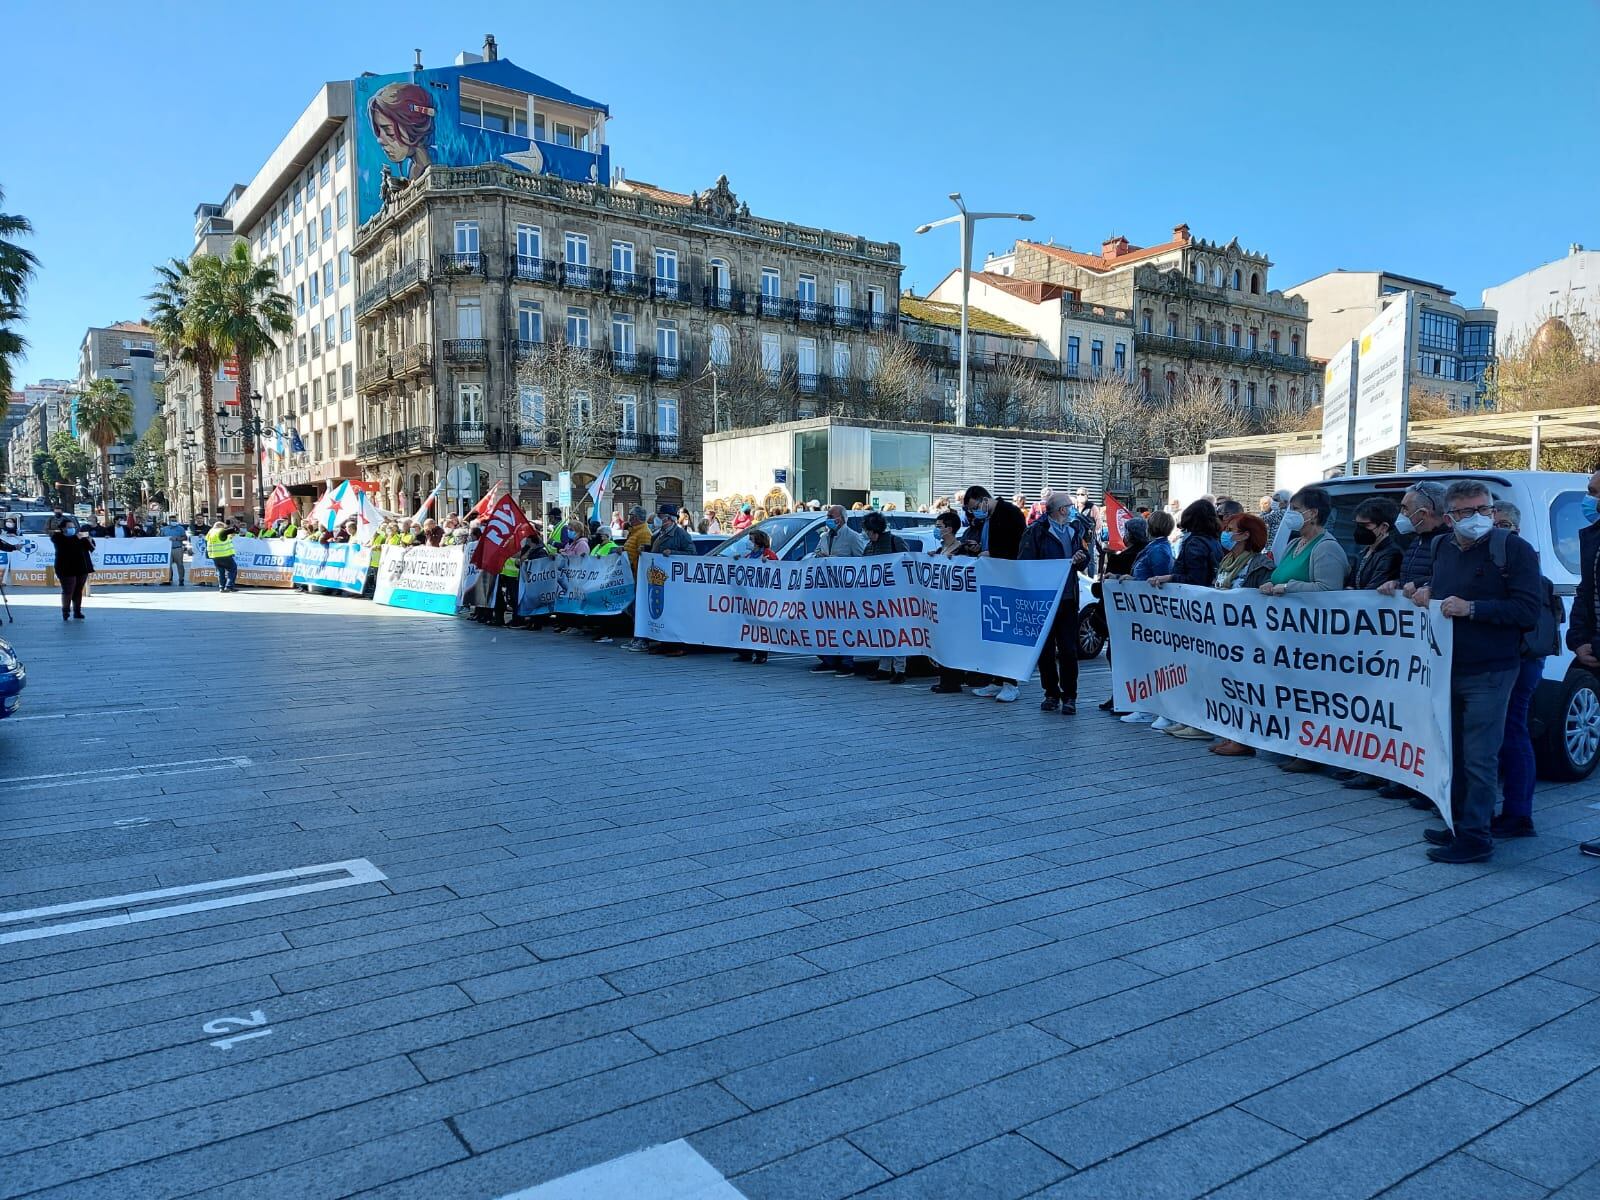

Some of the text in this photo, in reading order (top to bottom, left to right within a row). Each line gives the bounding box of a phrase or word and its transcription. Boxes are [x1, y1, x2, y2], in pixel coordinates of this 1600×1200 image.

[105, 554, 167, 564] SALVATERRA
[256, 556, 284, 566] ARBO
[527, 568, 556, 583] Contra
[671, 561, 782, 590] PLATAFORMA
[804, 562, 896, 590] SANIDADE
[708, 594, 940, 624] LOITANDO POR UNHA SANIDADE
[1015, 611, 1047, 626] GALEG
[1112, 591, 1137, 612] EN
[1138, 593, 1217, 626] DEFENSA
[1223, 603, 1258, 630] DA
[1266, 605, 1416, 639] SANIDADE
[815, 629, 840, 648] DE
[842, 627, 932, 649] CALIDADE
[1131, 622, 1245, 663] Recuperemos
[1253, 646, 1267, 665] a
[1273, 645, 1400, 680] Atención
[1126, 662, 1189, 704] Val Miñor
[1221, 677, 1403, 732] SEN PERSOAL
[1205, 698, 1426, 778] NON HAI SANIDADE
[202, 1009, 273, 1051] 12
